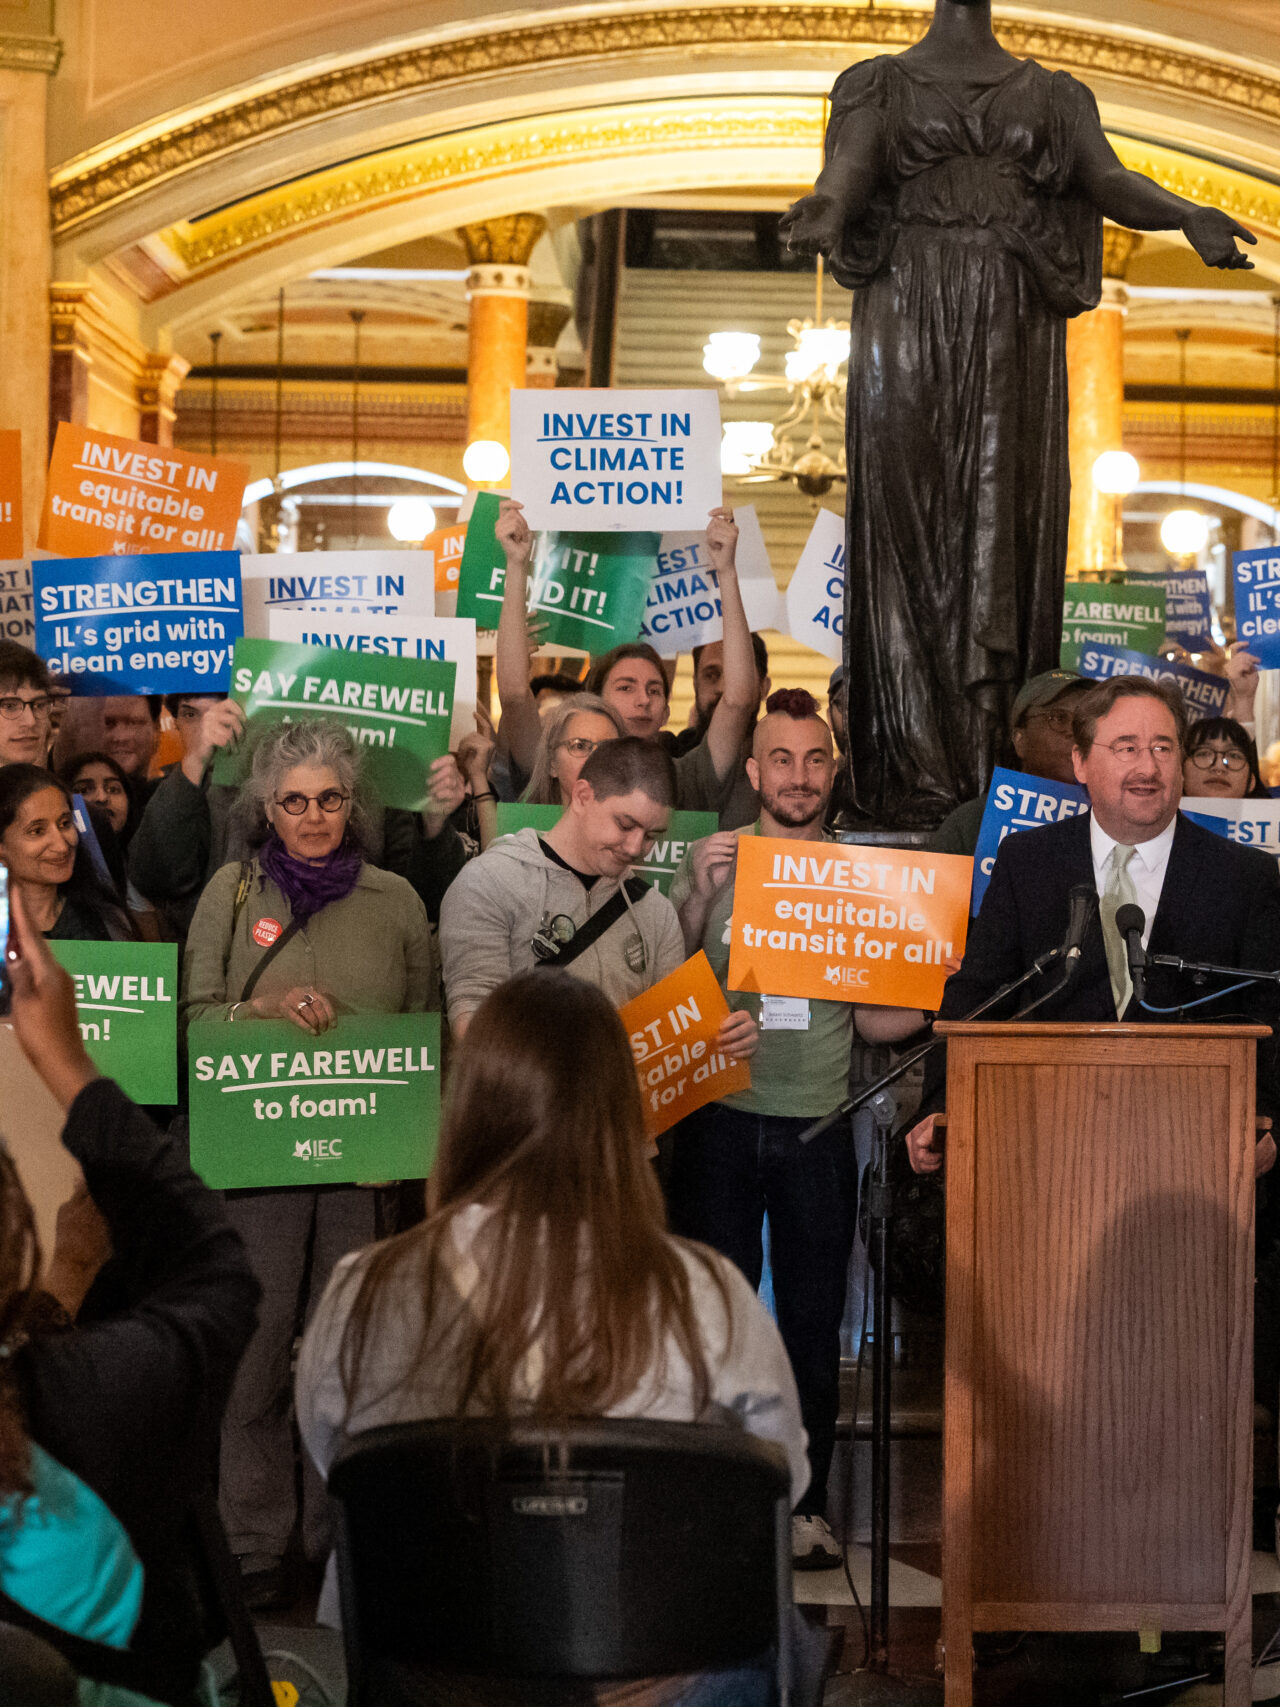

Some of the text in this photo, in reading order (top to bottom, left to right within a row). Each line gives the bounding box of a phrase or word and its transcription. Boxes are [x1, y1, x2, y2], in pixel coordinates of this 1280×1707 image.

[543, 413, 691, 437] INVEST IN
[81, 442, 217, 492] INVEST IN
[550, 447, 684, 471] CLIMATE
[80, 480, 204, 521] equitable
[550, 480, 683, 505] ACTION!
[52, 495, 224, 551] transit for all!
[562, 548, 599, 577] IT!
[658, 544, 699, 575] EST
[40, 578, 236, 611] STRENGTHEN
[269, 575, 405, 599] INVEST IN
[570, 587, 607, 615] IT!
[646, 569, 719, 607] LIMAT
[1063, 602, 1163, 623] FAREWELL
[104, 620, 160, 652] grid
[166, 618, 225, 641] with
[416, 638, 445, 661] IN
[47, 645, 234, 674] clean energy!
[235, 667, 449, 716] SAY FAREWELL
[1227, 821, 1271, 844] EST
[772, 854, 935, 895] INVEST IN
[775, 898, 927, 932] equitable
[742, 923, 953, 965] transit for all!
[73, 975, 171, 1002] EWELL
[842, 967, 870, 985] IEC
[668, 996, 702, 1036] IN
[195, 1047, 435, 1081] SAY FAREWELL
[254, 1092, 376, 1120] to foam!
[650, 1077, 687, 1112] for
[313, 1139, 342, 1157] IEC
